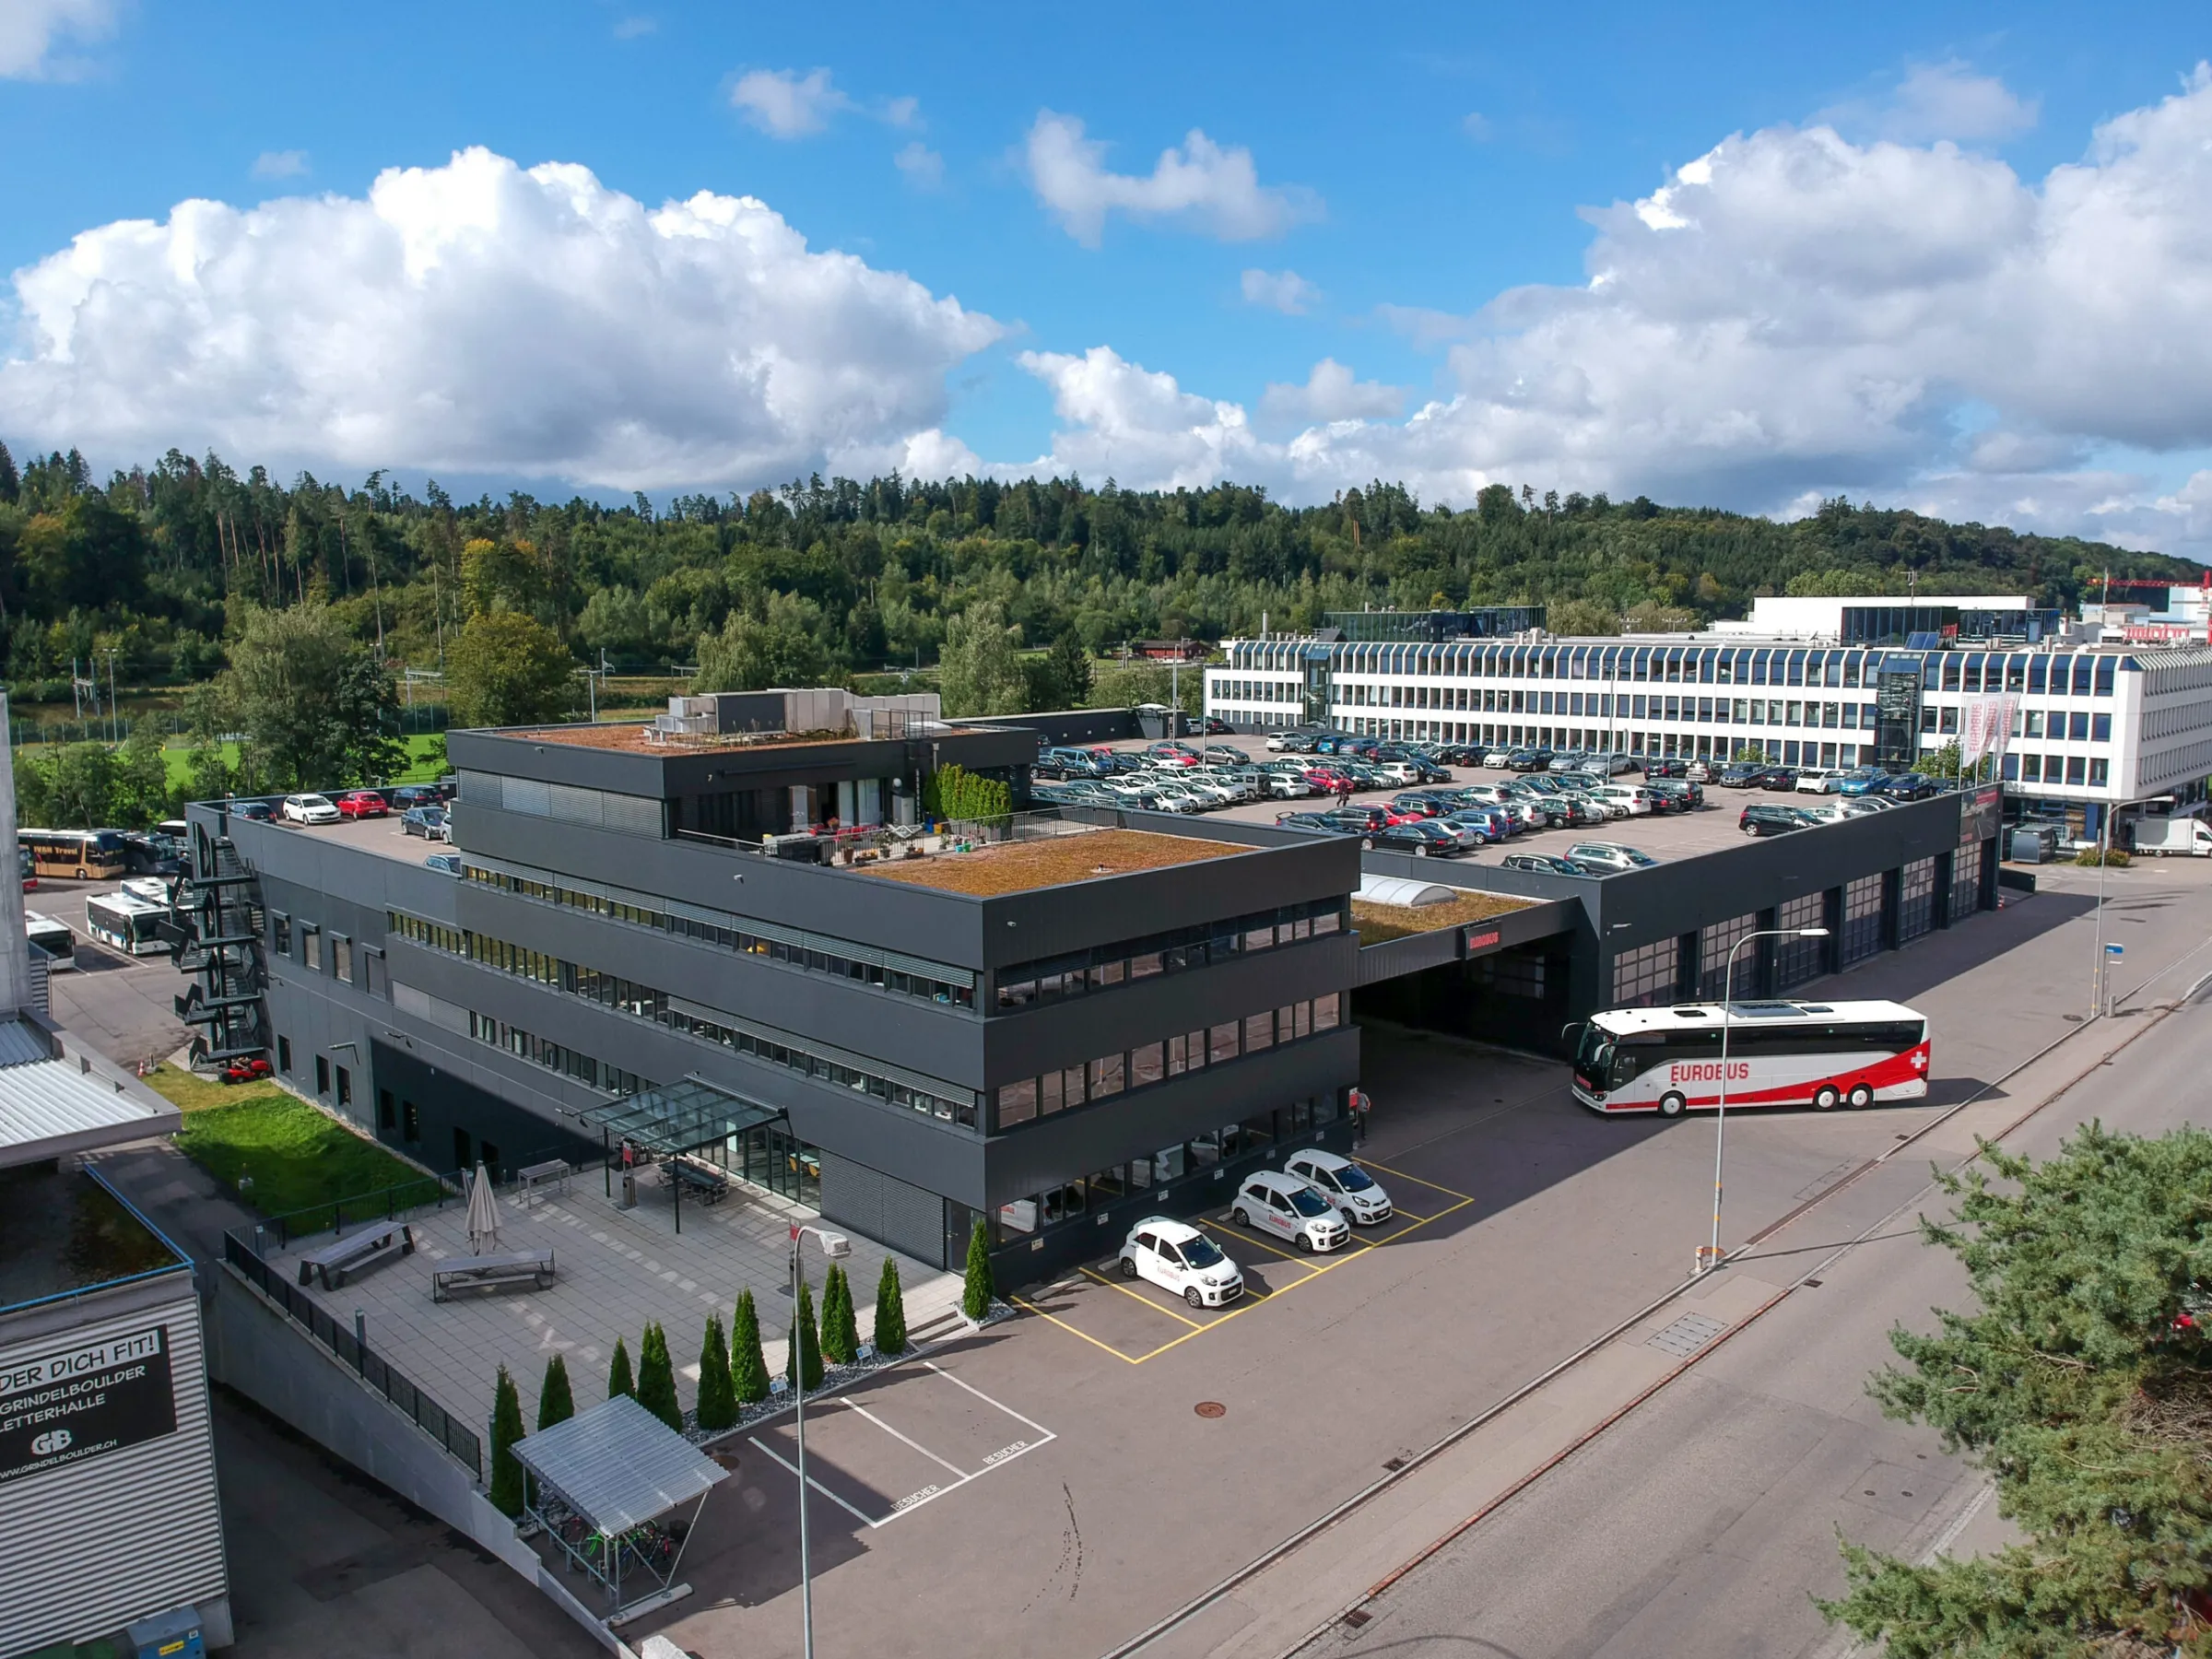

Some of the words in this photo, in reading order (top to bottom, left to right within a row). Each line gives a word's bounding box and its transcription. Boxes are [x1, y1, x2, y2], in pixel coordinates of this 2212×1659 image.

[1671, 1063, 1749, 1082] EUROBUS
[1268, 1214, 1291, 1229] EUROBUS
[51, 1349, 105, 1379] DICH
[113, 1334, 155, 1361] FIT!
[0, 1365, 146, 1416] GRINDELBOULDER
[982, 1441, 1029, 1465] BESUCHER
[890, 1484, 941, 1512] BESUCHER
